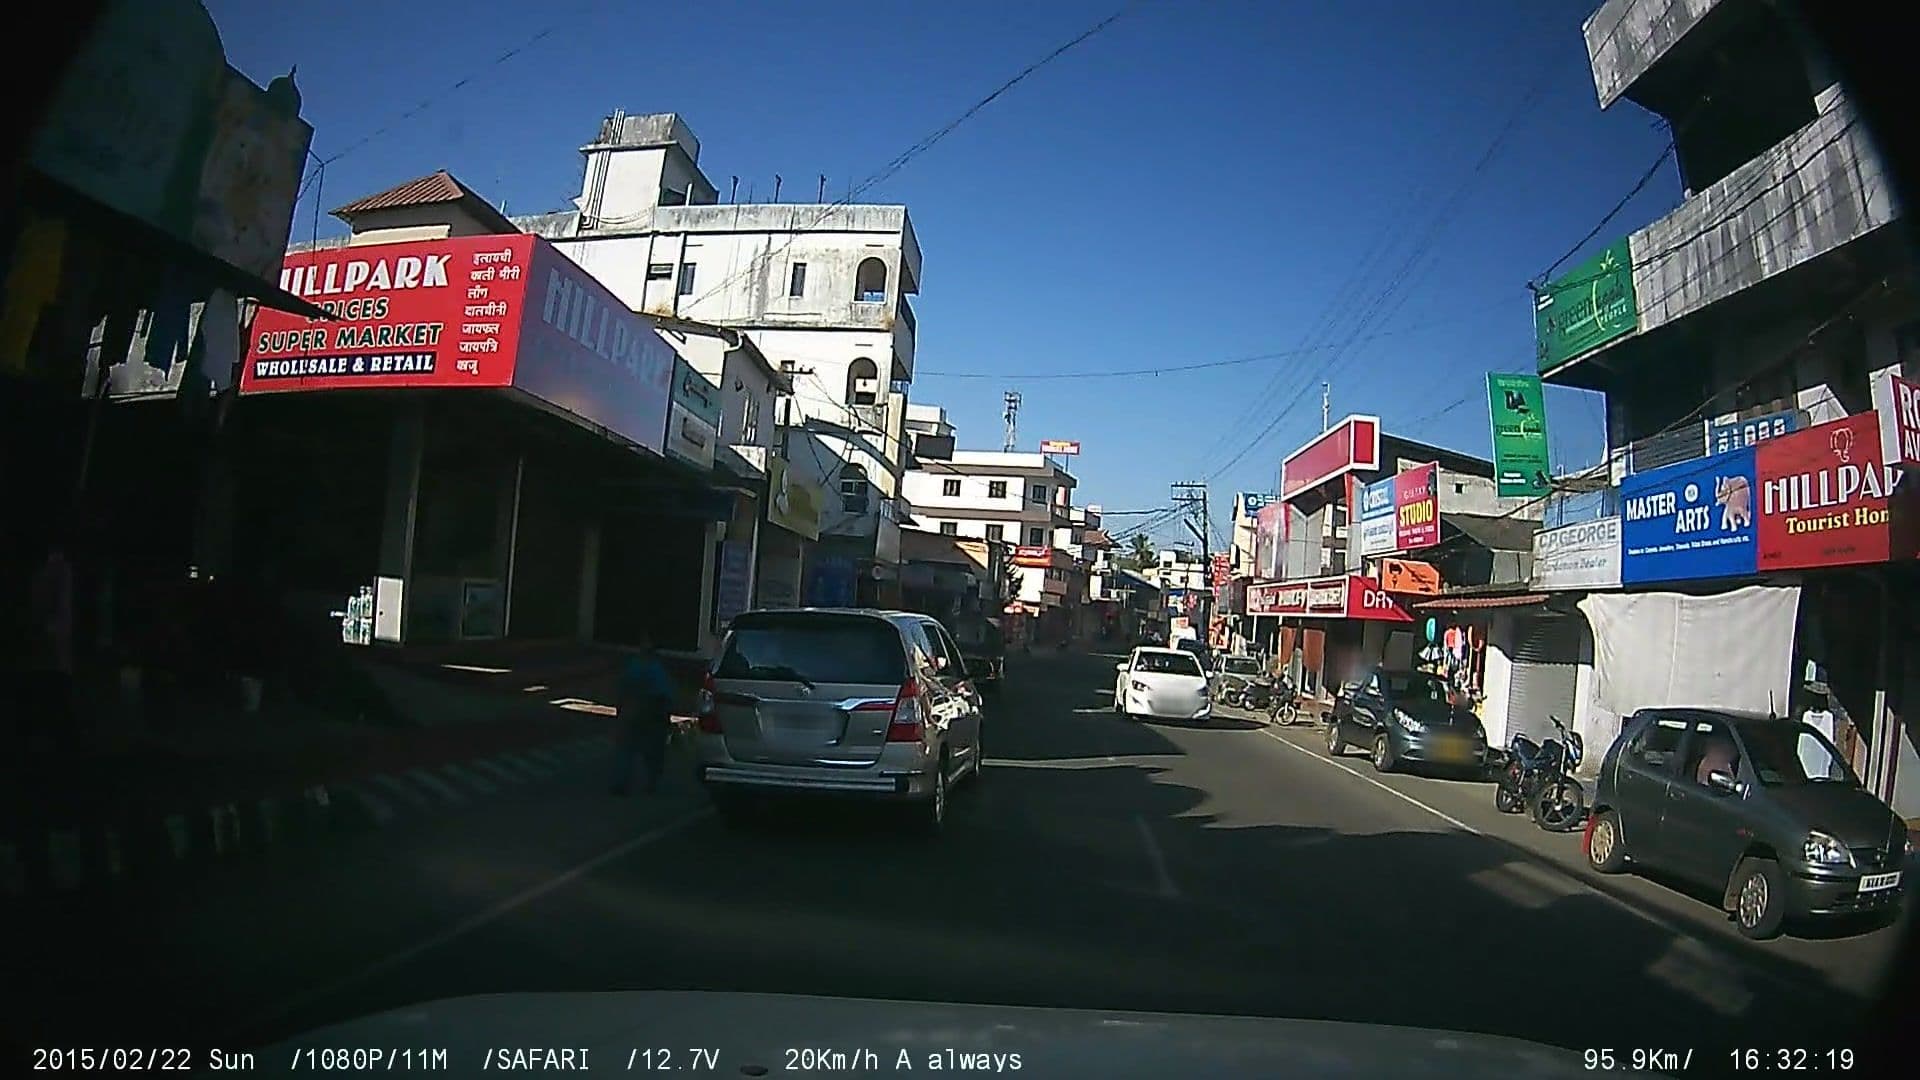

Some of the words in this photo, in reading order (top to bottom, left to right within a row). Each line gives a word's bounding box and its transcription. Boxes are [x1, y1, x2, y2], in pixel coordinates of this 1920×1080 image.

[257, 328, 328, 354] SUPER
[335, 323, 445, 349] MARKET
[352, 356, 365, 372] &
[370, 354, 434, 373] RETAIL
[1399, 498, 1434, 527] STUDIO
[1626, 491, 1676, 521] MASTER
[1675, 505, 1710, 533] ARTS
[1785, 512, 1849, 534] Tourist
